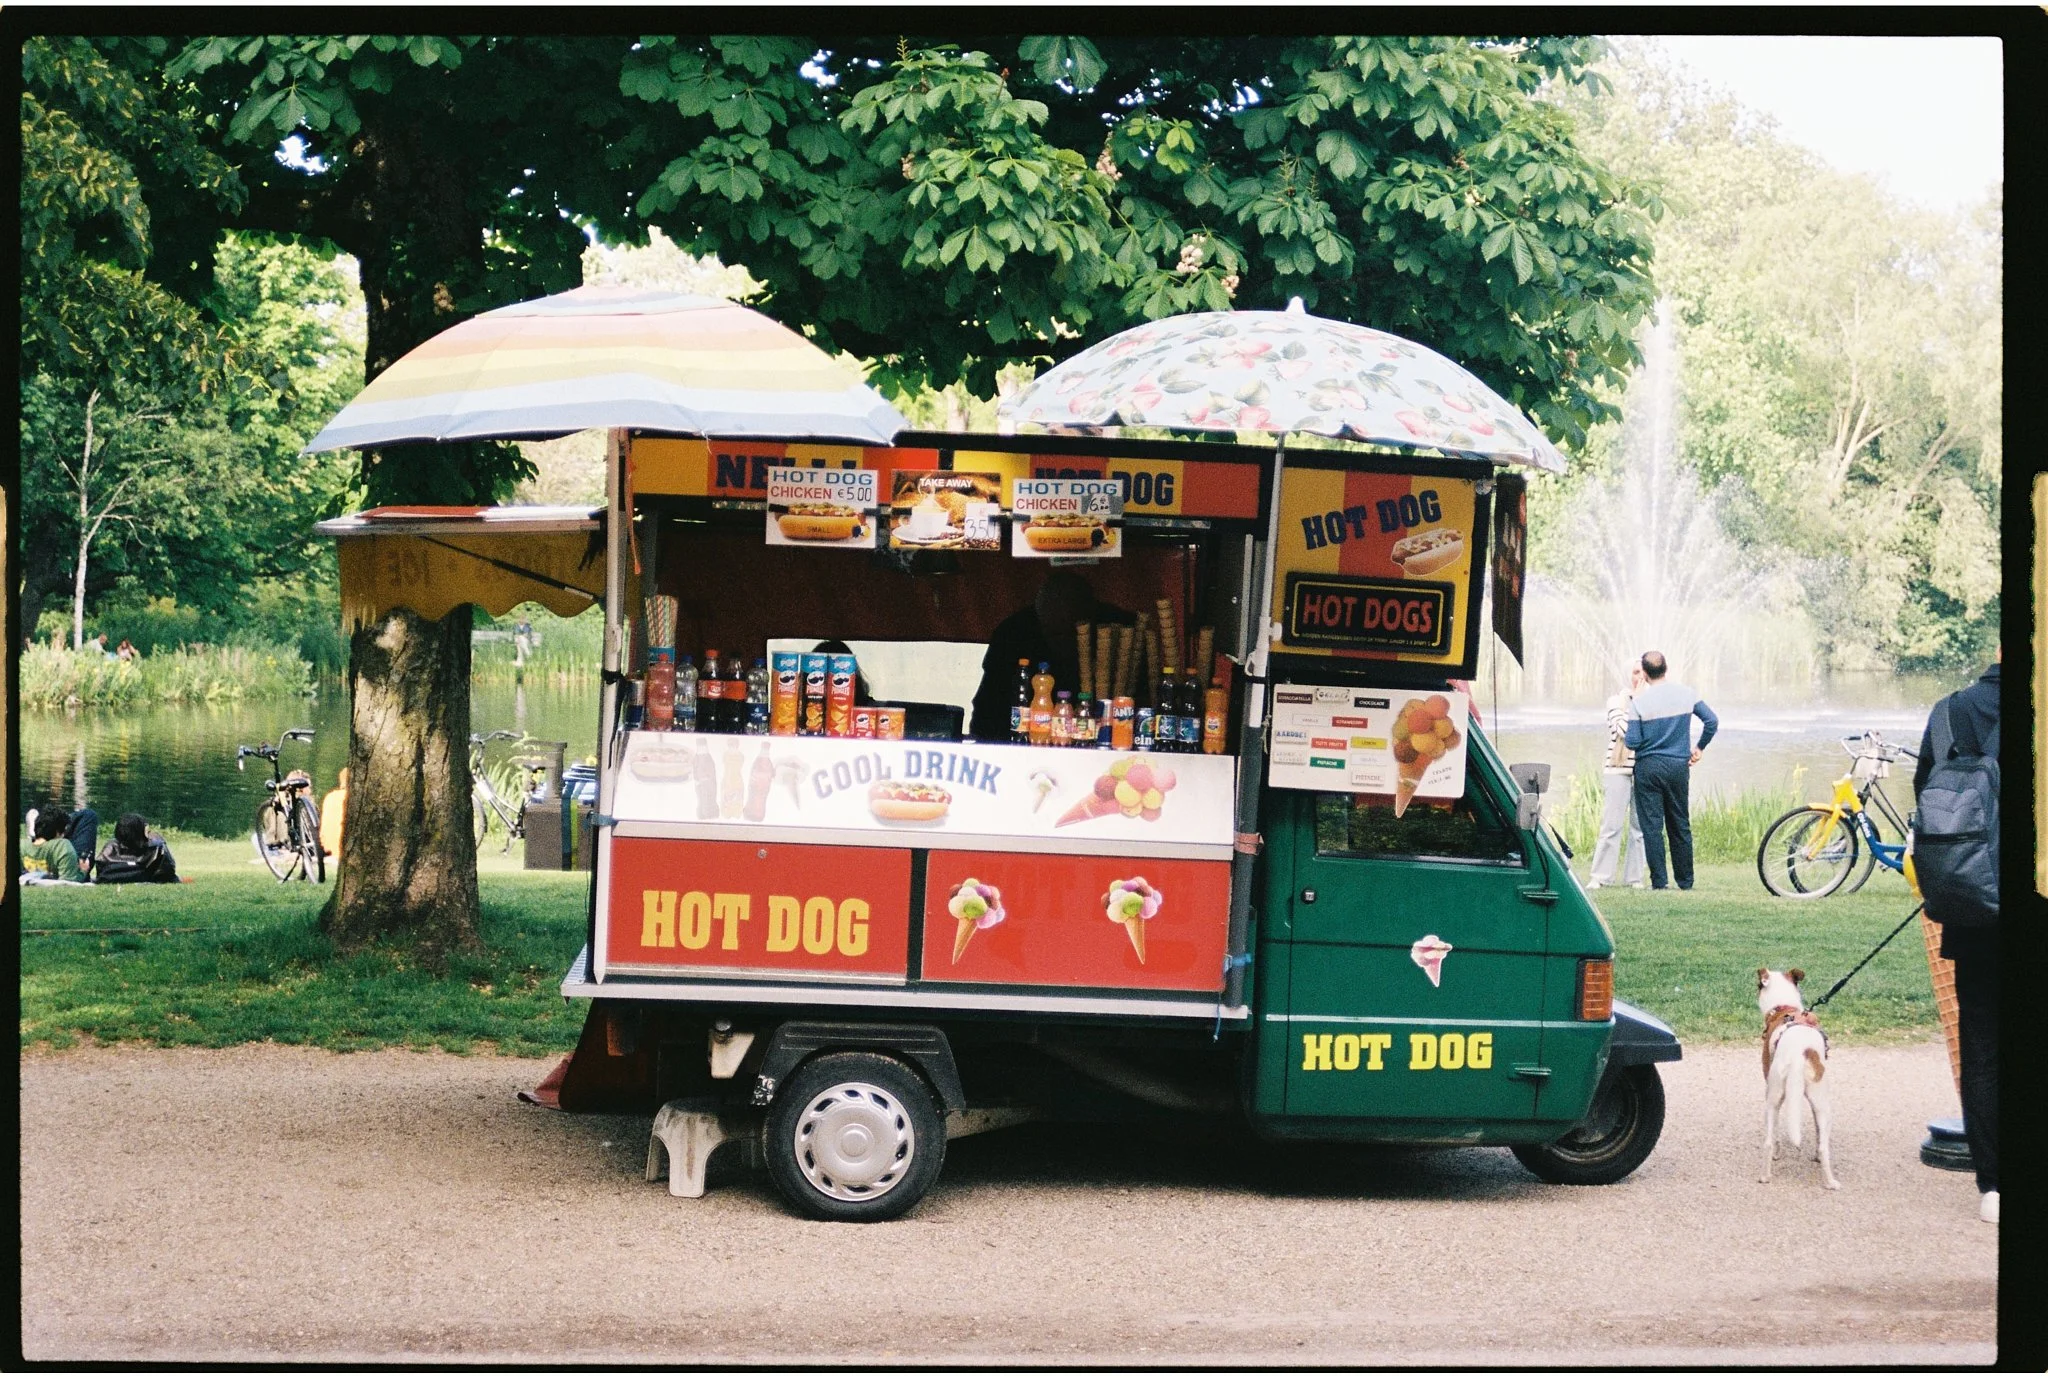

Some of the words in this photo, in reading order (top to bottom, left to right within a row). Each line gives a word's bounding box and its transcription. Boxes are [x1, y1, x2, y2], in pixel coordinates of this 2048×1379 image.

[773, 470, 819, 484] HOT
[825, 472, 873, 486] DOG
[920, 478, 944, 487] TAKE
[946, 479, 973, 488] AWAY
[770, 486, 832, 500] CHICKEN
[1018, 482, 1063, 495] HOT
[1071, 483, 1117, 495] DOG
[1016, 498, 1077, 511] CHICKEN
[1301, 506, 1367, 550] HOT
[1376, 489, 1442, 534] DOG
[807, 526, 832, 534] SMALL
[1038, 537, 1061, 545] EXTRA
[1063, 538, 1088, 546] LARGE
[1303, 593, 1357, 628] HOT
[1364, 597, 1433, 634] DOGS
[812, 752, 891, 799] COOL
[904, 750, 1001, 795] DRINK
[641, 890, 750, 950] HOT
[766, 895, 869, 956] DOG
[1303, 1034, 1391, 1070] HOT
[1409, 1033, 1492, 1070] DOG
